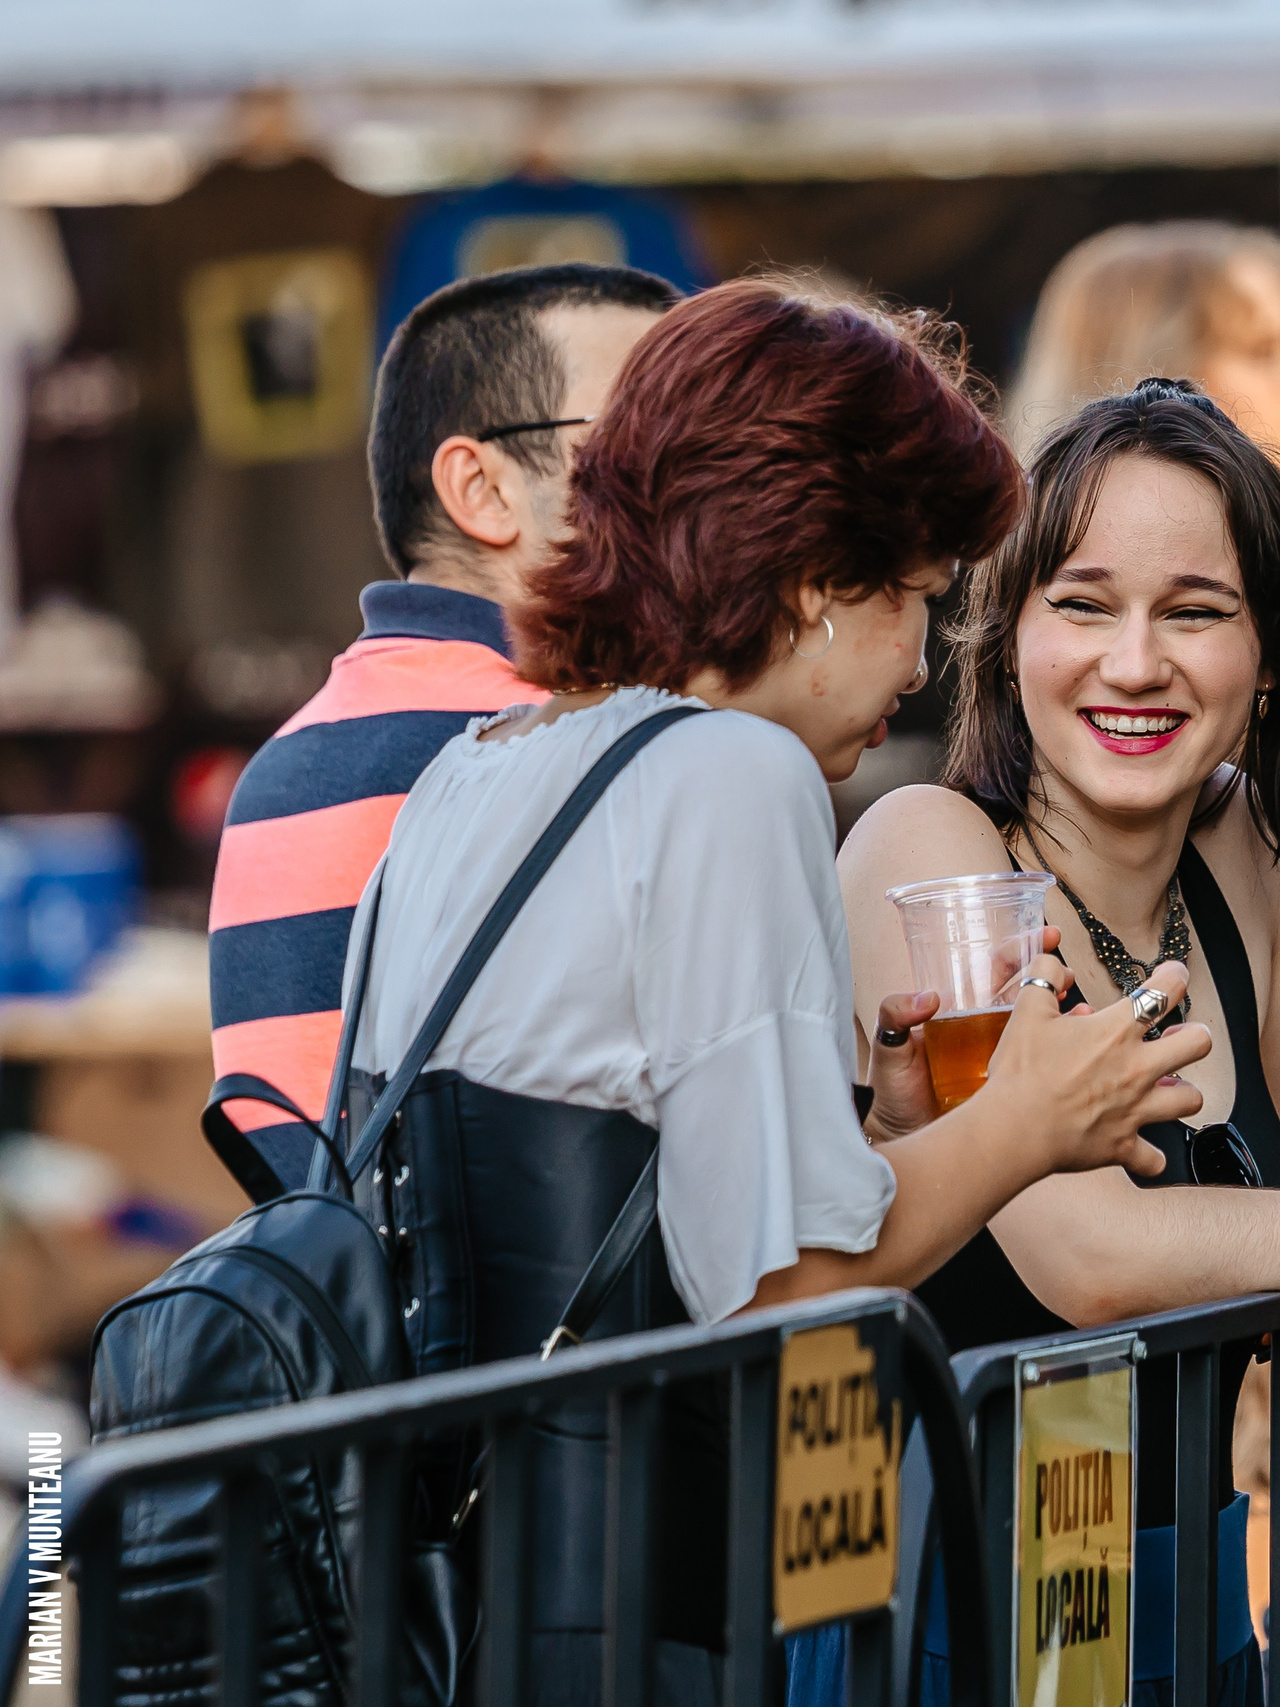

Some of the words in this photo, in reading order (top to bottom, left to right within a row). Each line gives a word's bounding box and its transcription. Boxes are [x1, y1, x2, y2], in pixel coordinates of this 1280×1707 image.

[784, 1371, 880, 1464] POLIȚI
[782, 1468, 887, 1575] LOCALĂ
[1035, 1547, 1111, 1655] LOCALĂ
